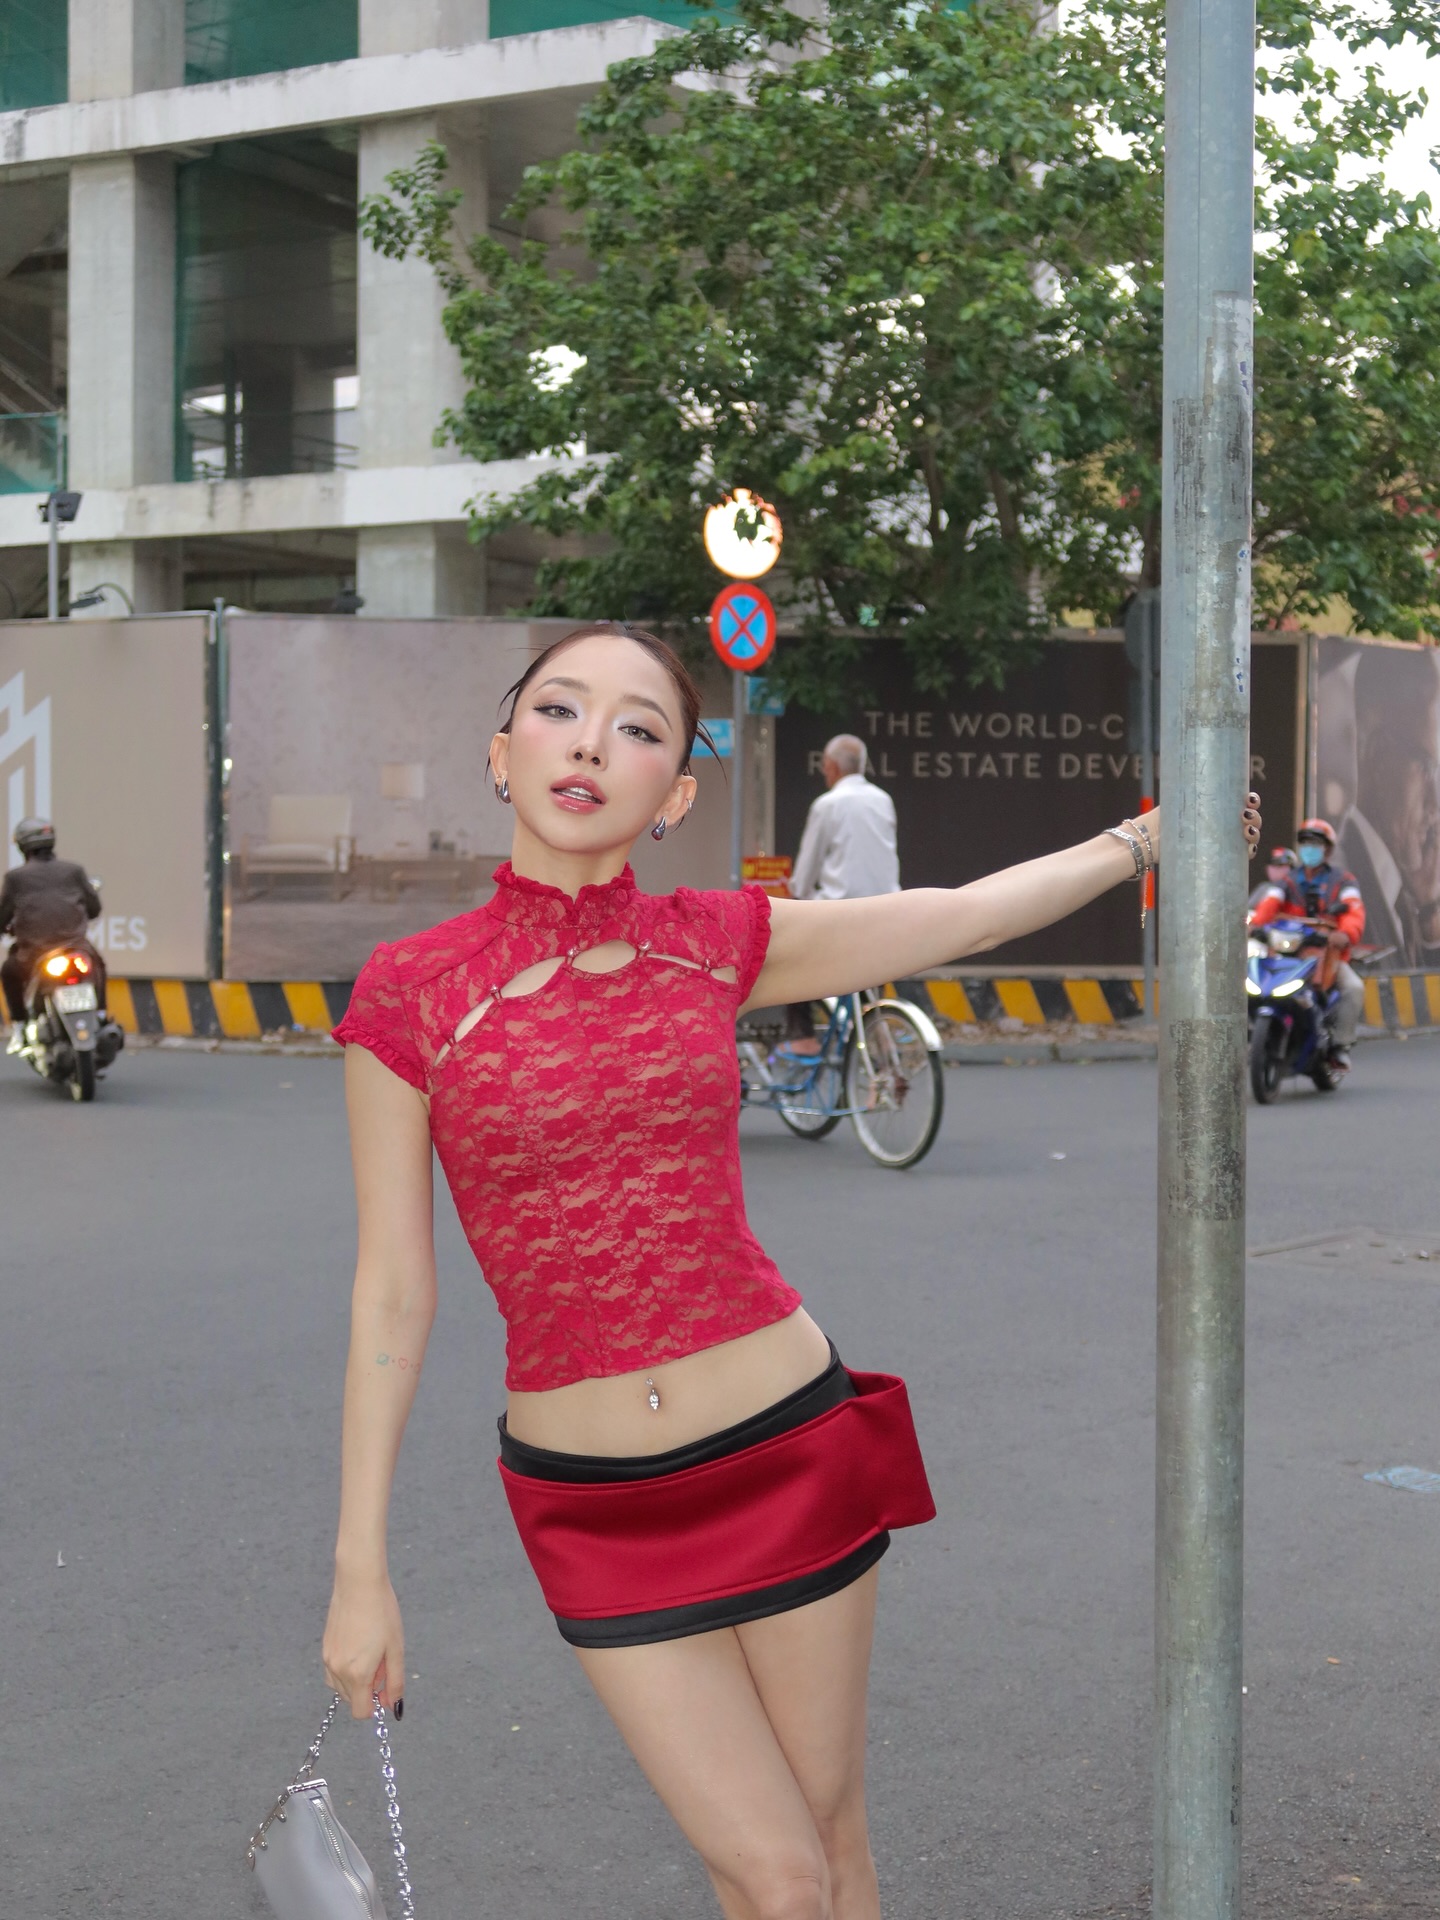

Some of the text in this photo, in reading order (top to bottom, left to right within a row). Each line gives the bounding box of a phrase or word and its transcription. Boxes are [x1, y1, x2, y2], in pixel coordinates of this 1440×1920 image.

[865, 710, 1124, 740] THE WORLD-C
[912, 751, 1042, 779] ESTATE
